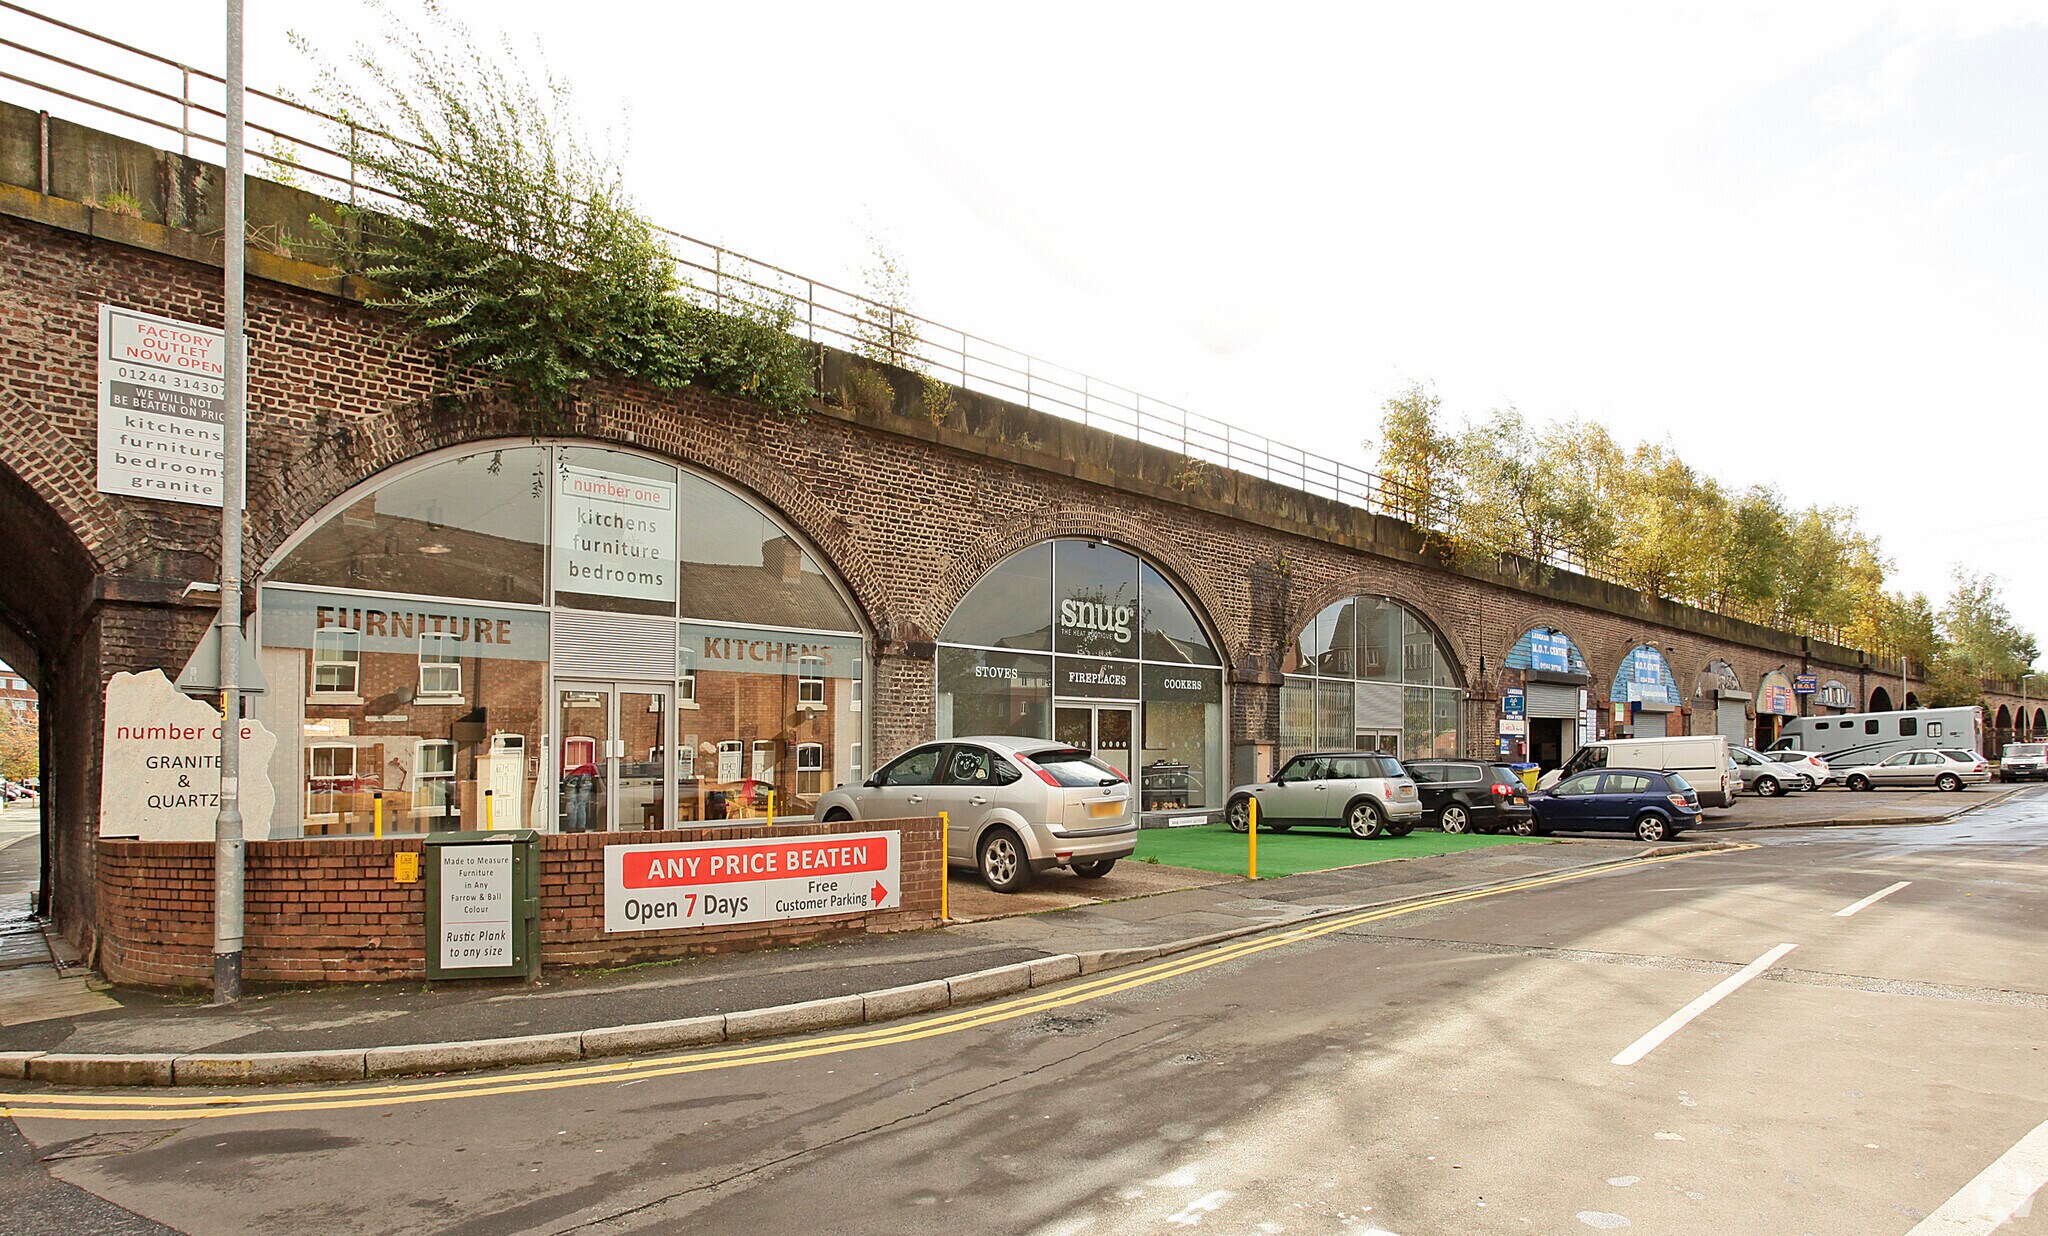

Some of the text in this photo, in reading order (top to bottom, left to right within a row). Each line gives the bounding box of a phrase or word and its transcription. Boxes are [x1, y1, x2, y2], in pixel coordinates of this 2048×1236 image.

[138, 324, 213, 348] FACTORY
[143, 338, 208, 358] OUTLET
[126, 346, 222, 374] NOW OPEN
[118, 368, 166, 384] 01244
[136, 388, 212, 410] WE WILL NOT
[114, 394, 224, 422] BE BEATEN ON PRIC
[125, 416, 220, 441] kitchens
[120, 434, 224, 460] furniture
[131, 477, 212, 494] granite
[574, 480, 660, 502] number one
[578, 507, 656, 533] kitchens
[573, 534, 660, 560] furniture
[570, 560, 663, 586] bedrooms
[316, 606, 512, 644] FURNITURE
[1061, 598, 1134, 643] snug
[1062, 628, 1072, 636] THE
[704, 636, 832, 666] KITCHENS
[1532, 643, 1550, 654] M.O.T.
[976, 666, 1018, 679] STOVES
[1068, 672, 1126, 686] FIREPLACES
[1164, 678, 1202, 690] COOKERS
[118, 723, 251, 740] number oe
[146, 756, 222, 768] GRANITE
[178, 774, 190, 788] &
[148, 794, 218, 809] QUARTZ
[478, 856, 508, 864] Measure
[648, 846, 866, 880] ANY PRICE BEATEN
[459, 868, 494, 876] Furniture
[474, 882, 488, 890] Any
[808, 881, 838, 893] Free
[452, 894, 476, 902] Farrow
[488, 892, 502, 900] Ball
[776, 892, 868, 912] Customer Parking
[464, 906, 488, 914] Colour
[625, 894, 748, 924] Open 7 Days
[446, 930, 506, 942] Rustic Plank
[450, 946, 502, 958] to any size
